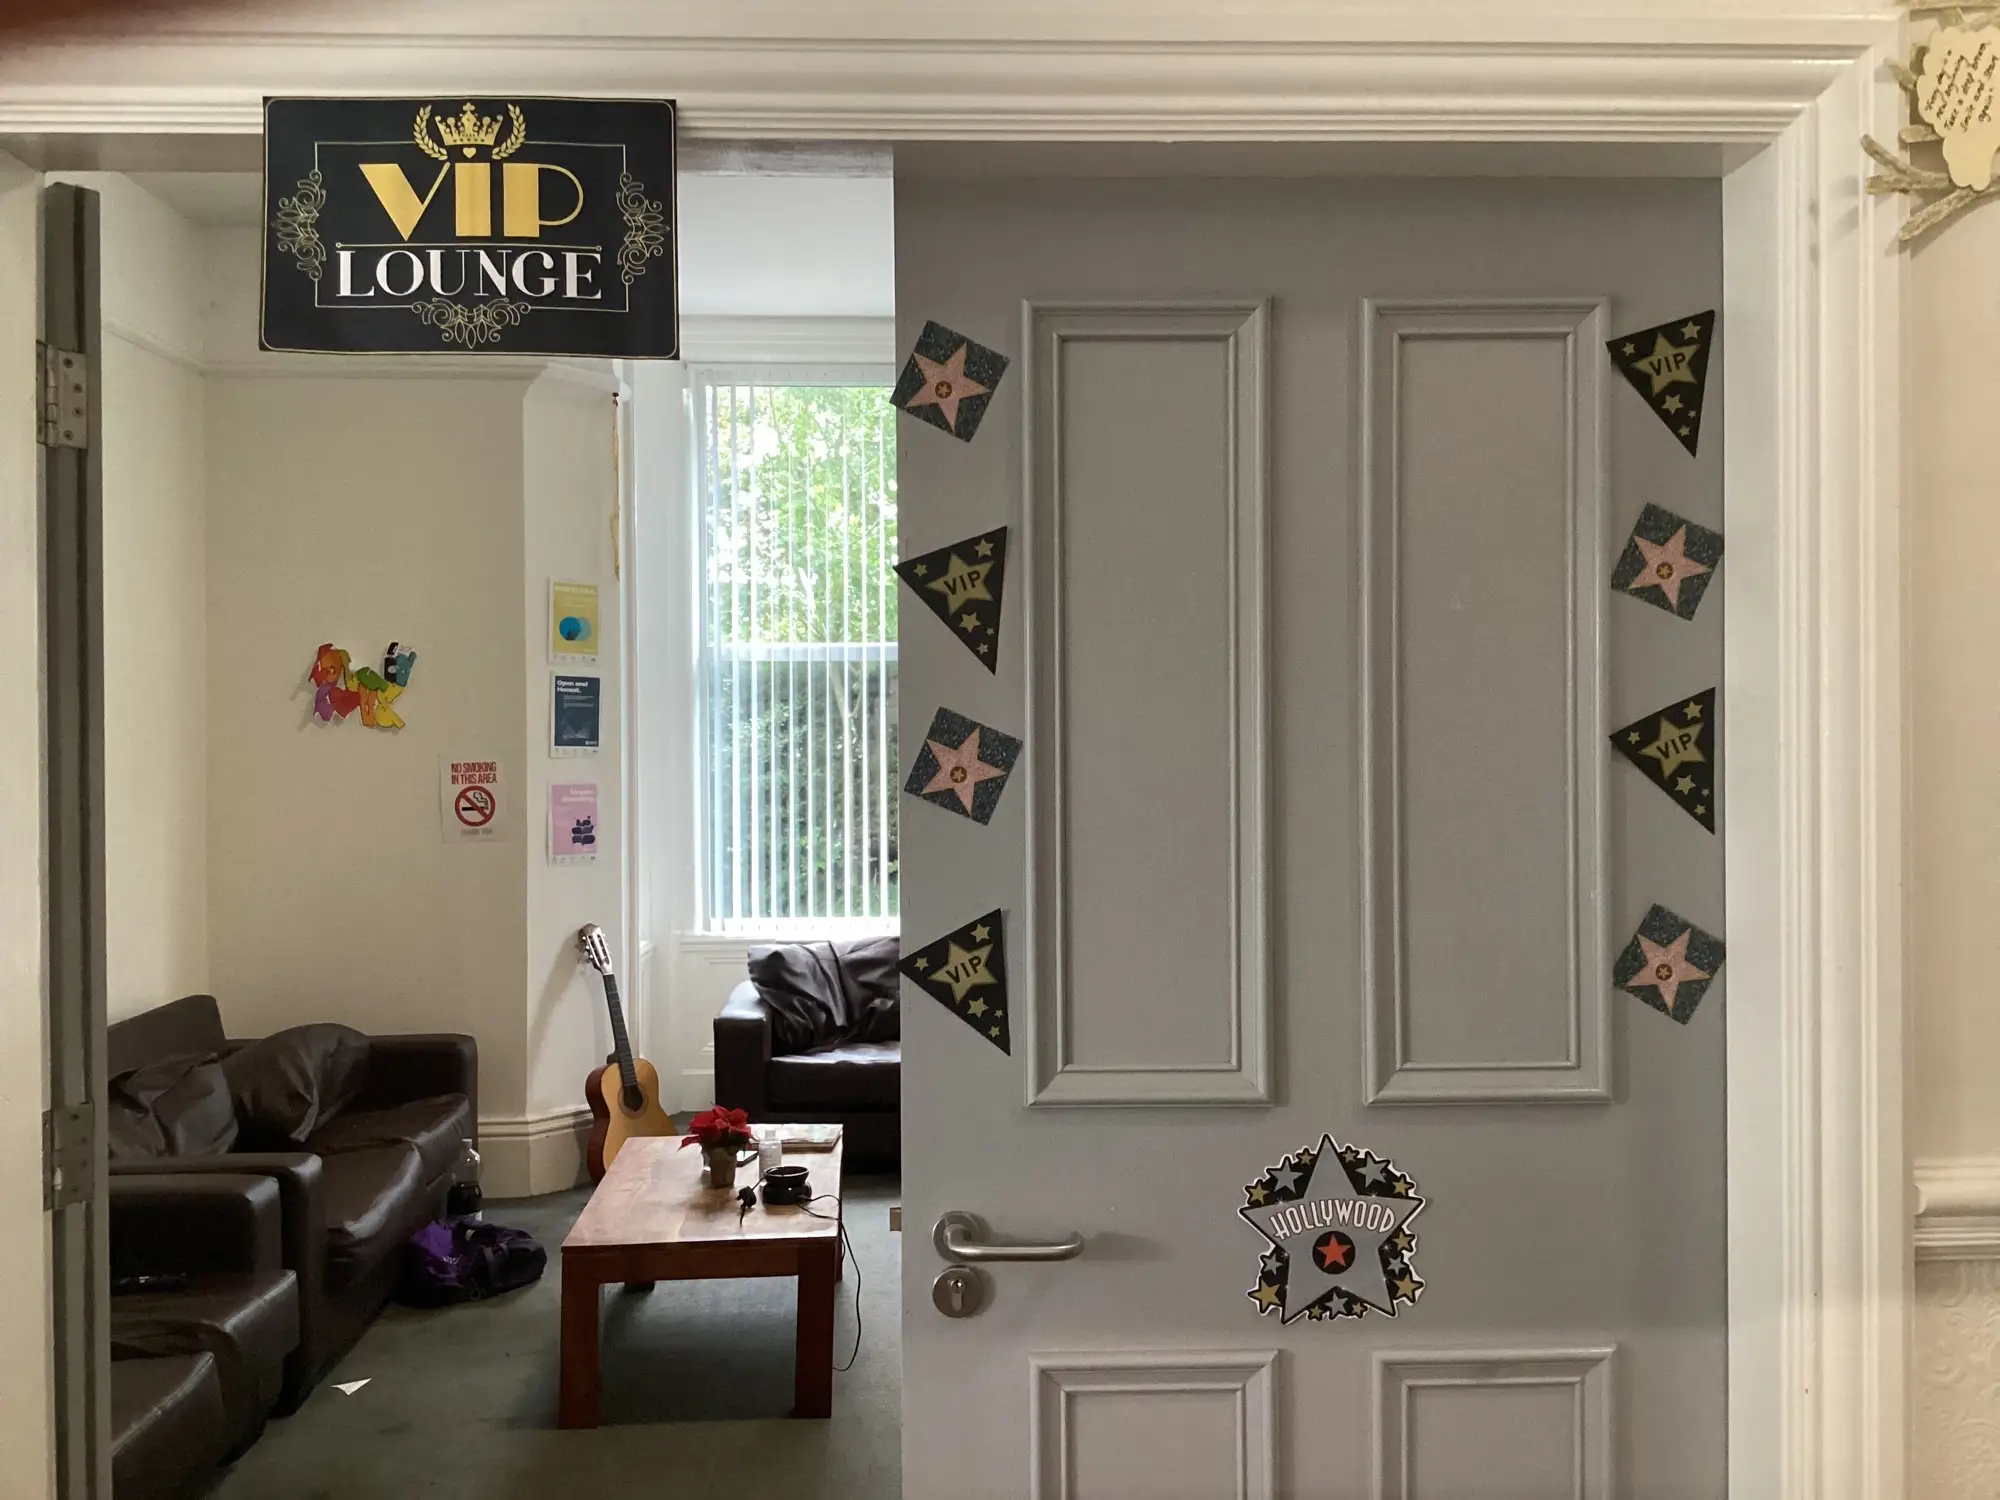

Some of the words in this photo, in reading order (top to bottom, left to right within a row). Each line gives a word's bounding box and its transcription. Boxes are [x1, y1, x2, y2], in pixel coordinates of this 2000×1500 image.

[359, 161, 584, 241] VIP
[335, 250, 602, 299] LOUNGE
[1649, 352, 1686, 376] VIP
[944, 570, 980, 595] VIP
[1656, 733, 1692, 759] VIP
[451, 763, 462, 773] NO
[463, 761, 497, 773] SMOKING
[451, 774, 459, 785] IN
[460, 774, 476, 785] THIS
[477, 773, 498, 784] AREA
[945, 956, 982, 983] VIP
[1269, 1199, 1396, 1240] HOLLYWOOD
